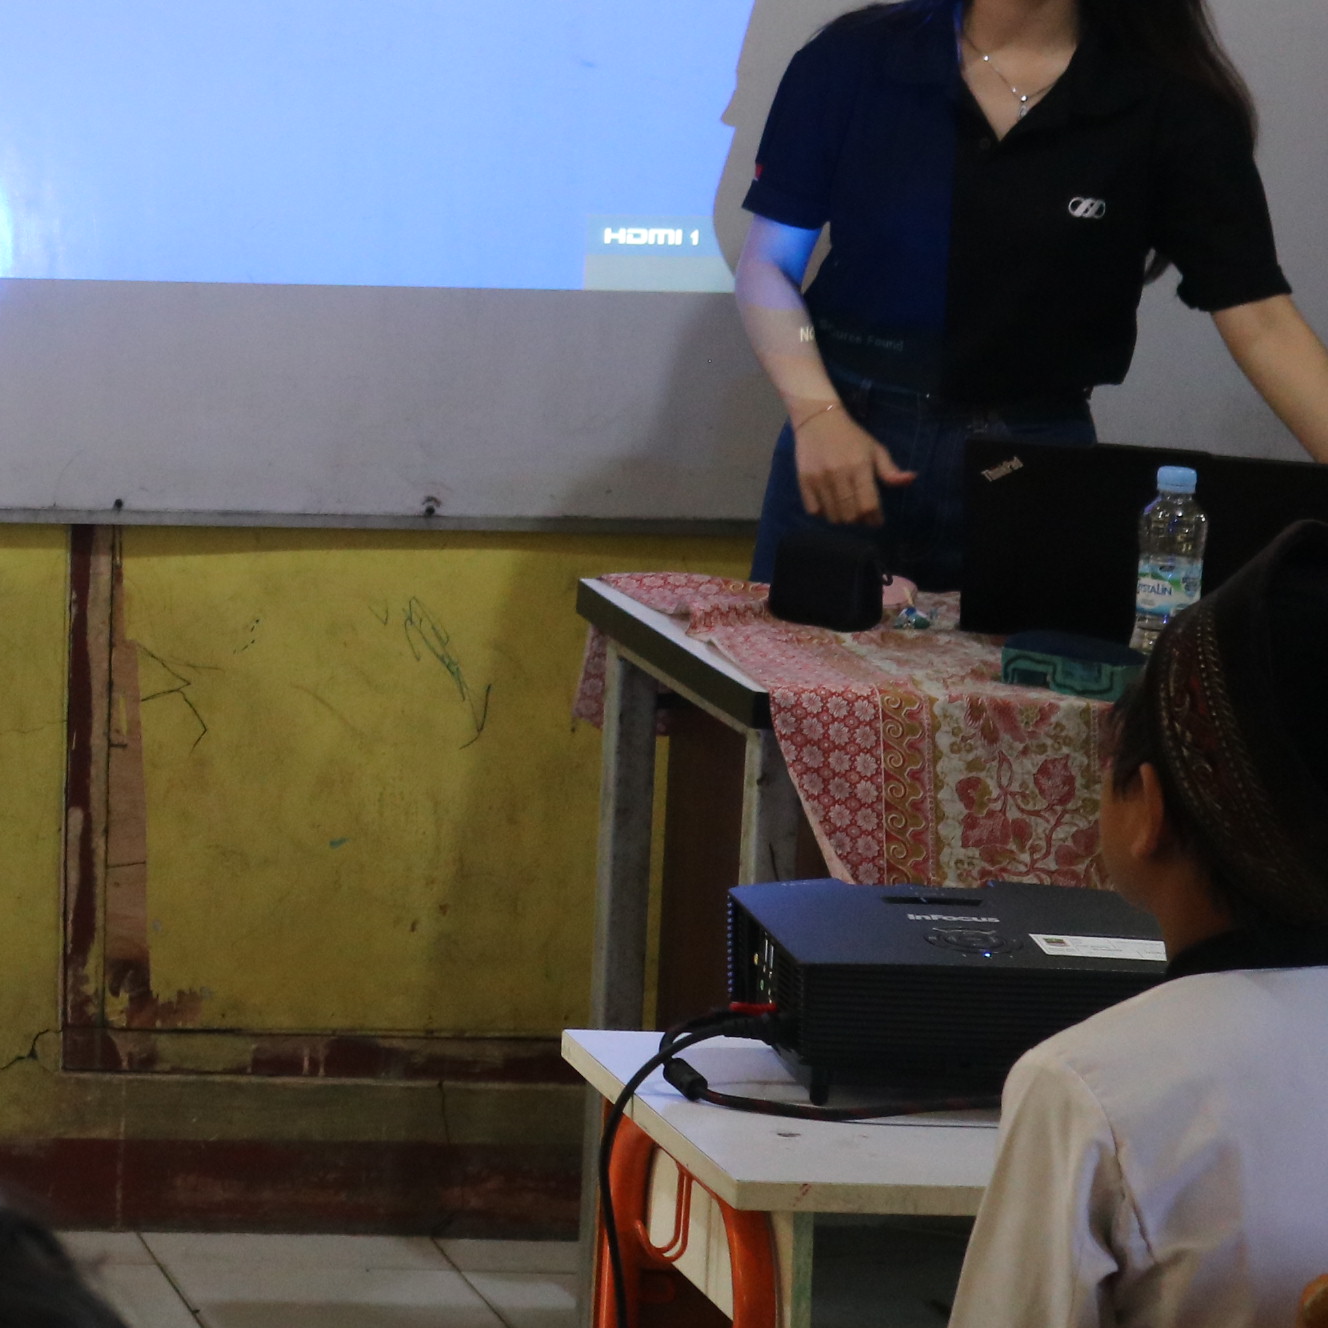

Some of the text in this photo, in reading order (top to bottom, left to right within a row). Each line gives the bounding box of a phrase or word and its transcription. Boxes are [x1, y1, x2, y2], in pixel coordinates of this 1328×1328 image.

[603, 227, 701, 246] HDMI 1
[906, 913, 1001, 924] InFocus
